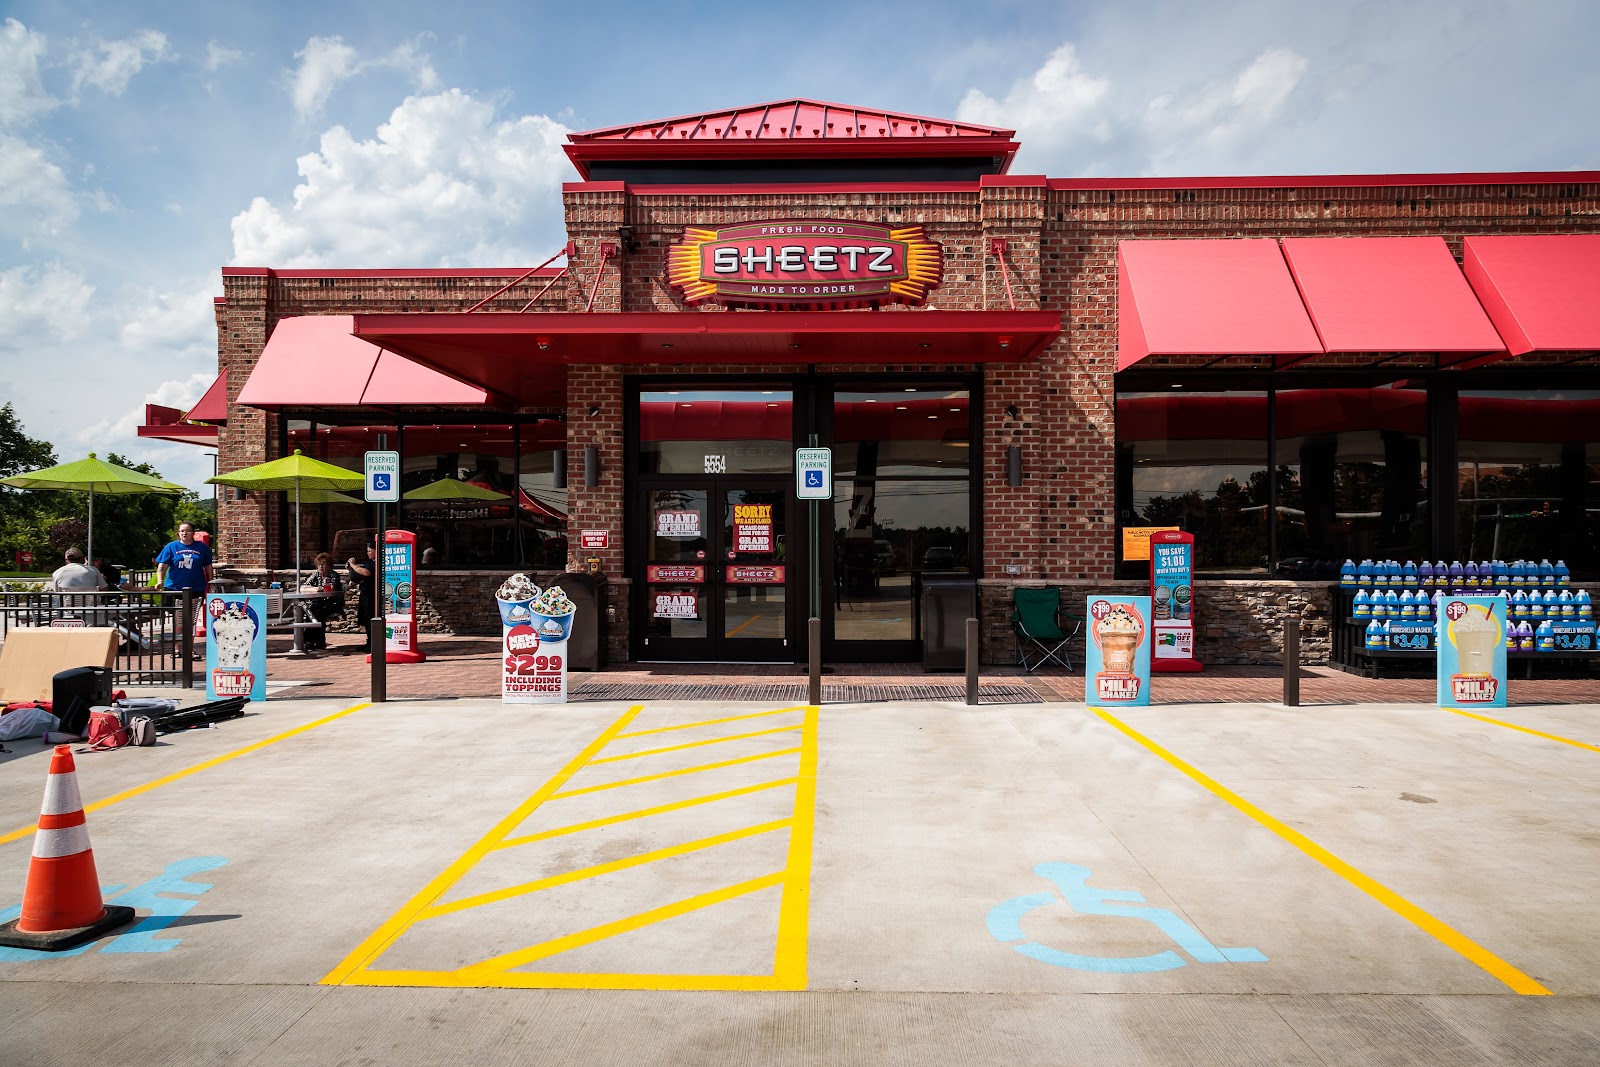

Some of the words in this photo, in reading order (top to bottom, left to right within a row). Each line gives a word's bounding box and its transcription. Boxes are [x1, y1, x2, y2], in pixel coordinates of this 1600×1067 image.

[762, 226, 802, 234] FRESH
[812, 226, 844, 234] FOOD
[714, 246, 893, 273] SHEETZ
[814, 285, 856, 293] ORDER
[704, 455, 726, 474] 5554
[734, 506, 771, 517] SORRY
[659, 514, 698, 524] GRAND
[659, 523, 699, 531] OPENING!
[385, 555, 406, 565] $1.00
[1162, 556, 1184, 567] $1.00
[656, 596, 695, 605] GRAND
[656, 605, 695, 613] OPENING!
[508, 633, 536, 644] NEW
[1393, 634, 1428, 647] $3.49
[1555, 635, 1590, 648] $3.49
[510, 641, 537, 650] PRICE
[216, 676, 251, 687] MILK
[1100, 680, 1137, 691] MILK
[1455, 681, 1495, 693] MILK
